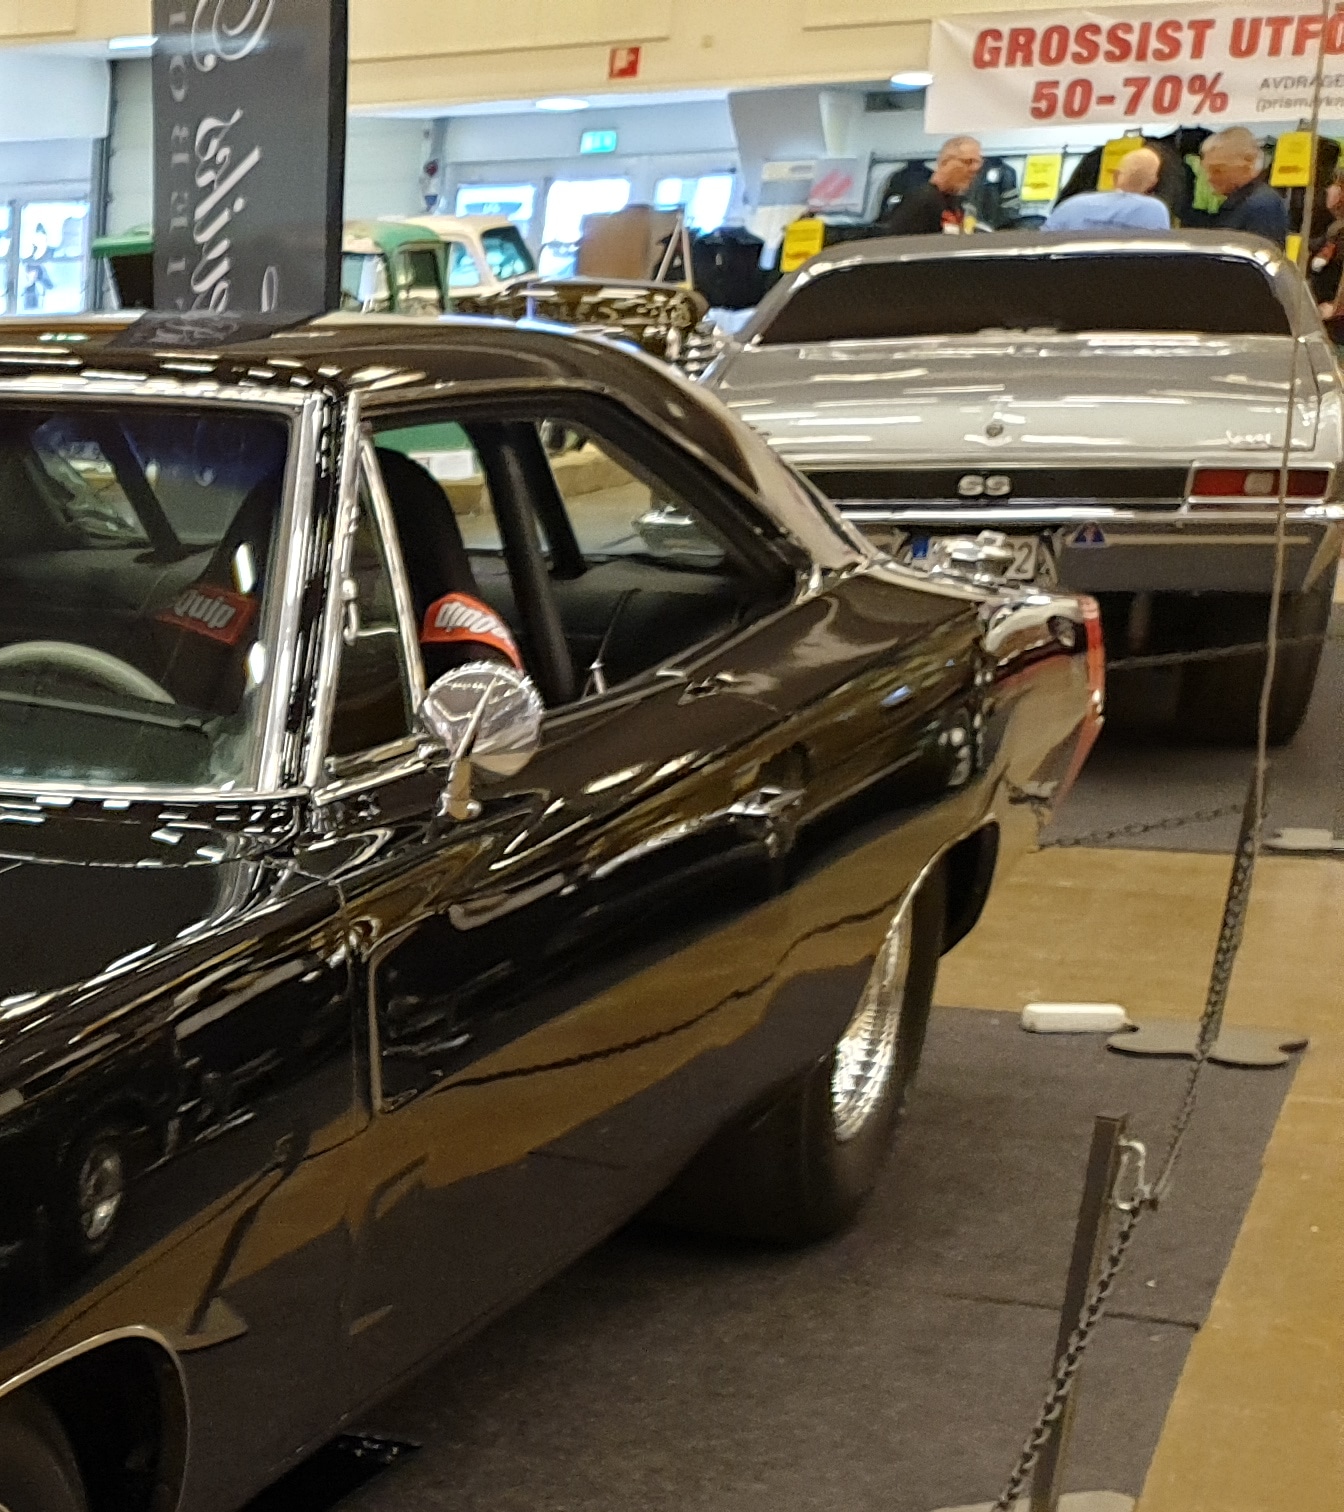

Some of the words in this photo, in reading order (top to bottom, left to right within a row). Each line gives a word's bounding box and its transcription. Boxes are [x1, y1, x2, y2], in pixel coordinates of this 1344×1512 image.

[973, 20, 1215, 70] GROSSIST
[1029, 72, 1230, 120] 50-70%
[957, 474, 1012, 496] SS
